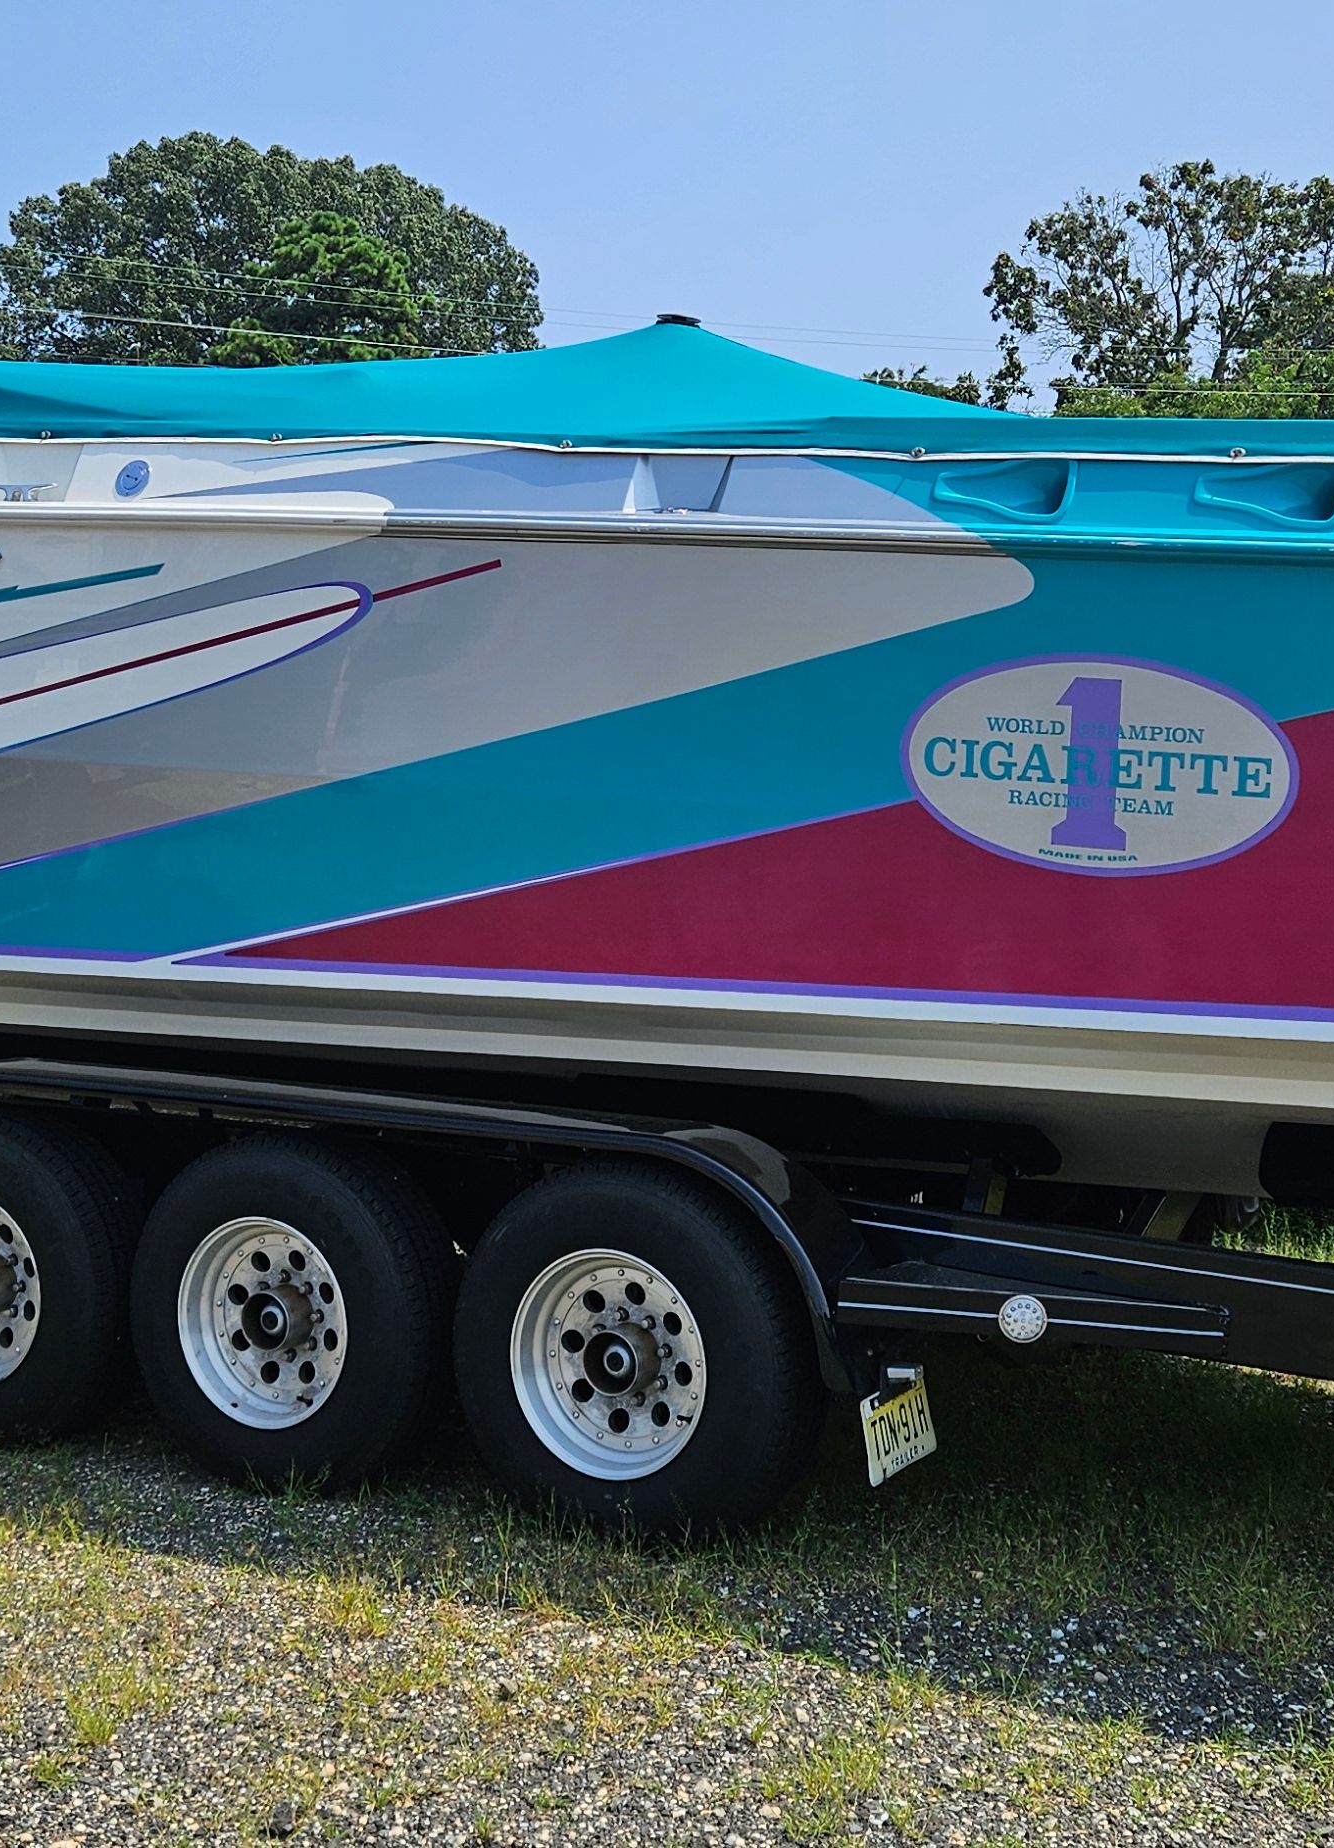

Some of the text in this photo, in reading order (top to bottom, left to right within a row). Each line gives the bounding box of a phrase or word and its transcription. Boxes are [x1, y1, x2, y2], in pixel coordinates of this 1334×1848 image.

[987, 717, 1205, 743] WORLD CHAMPION
[924, 736, 1273, 799] CIGARETTE
[1051, 676, 1127, 851] 1
[1008, 790, 1174, 816] RACING TEAM
[1038, 848, 1083, 860] MADE
